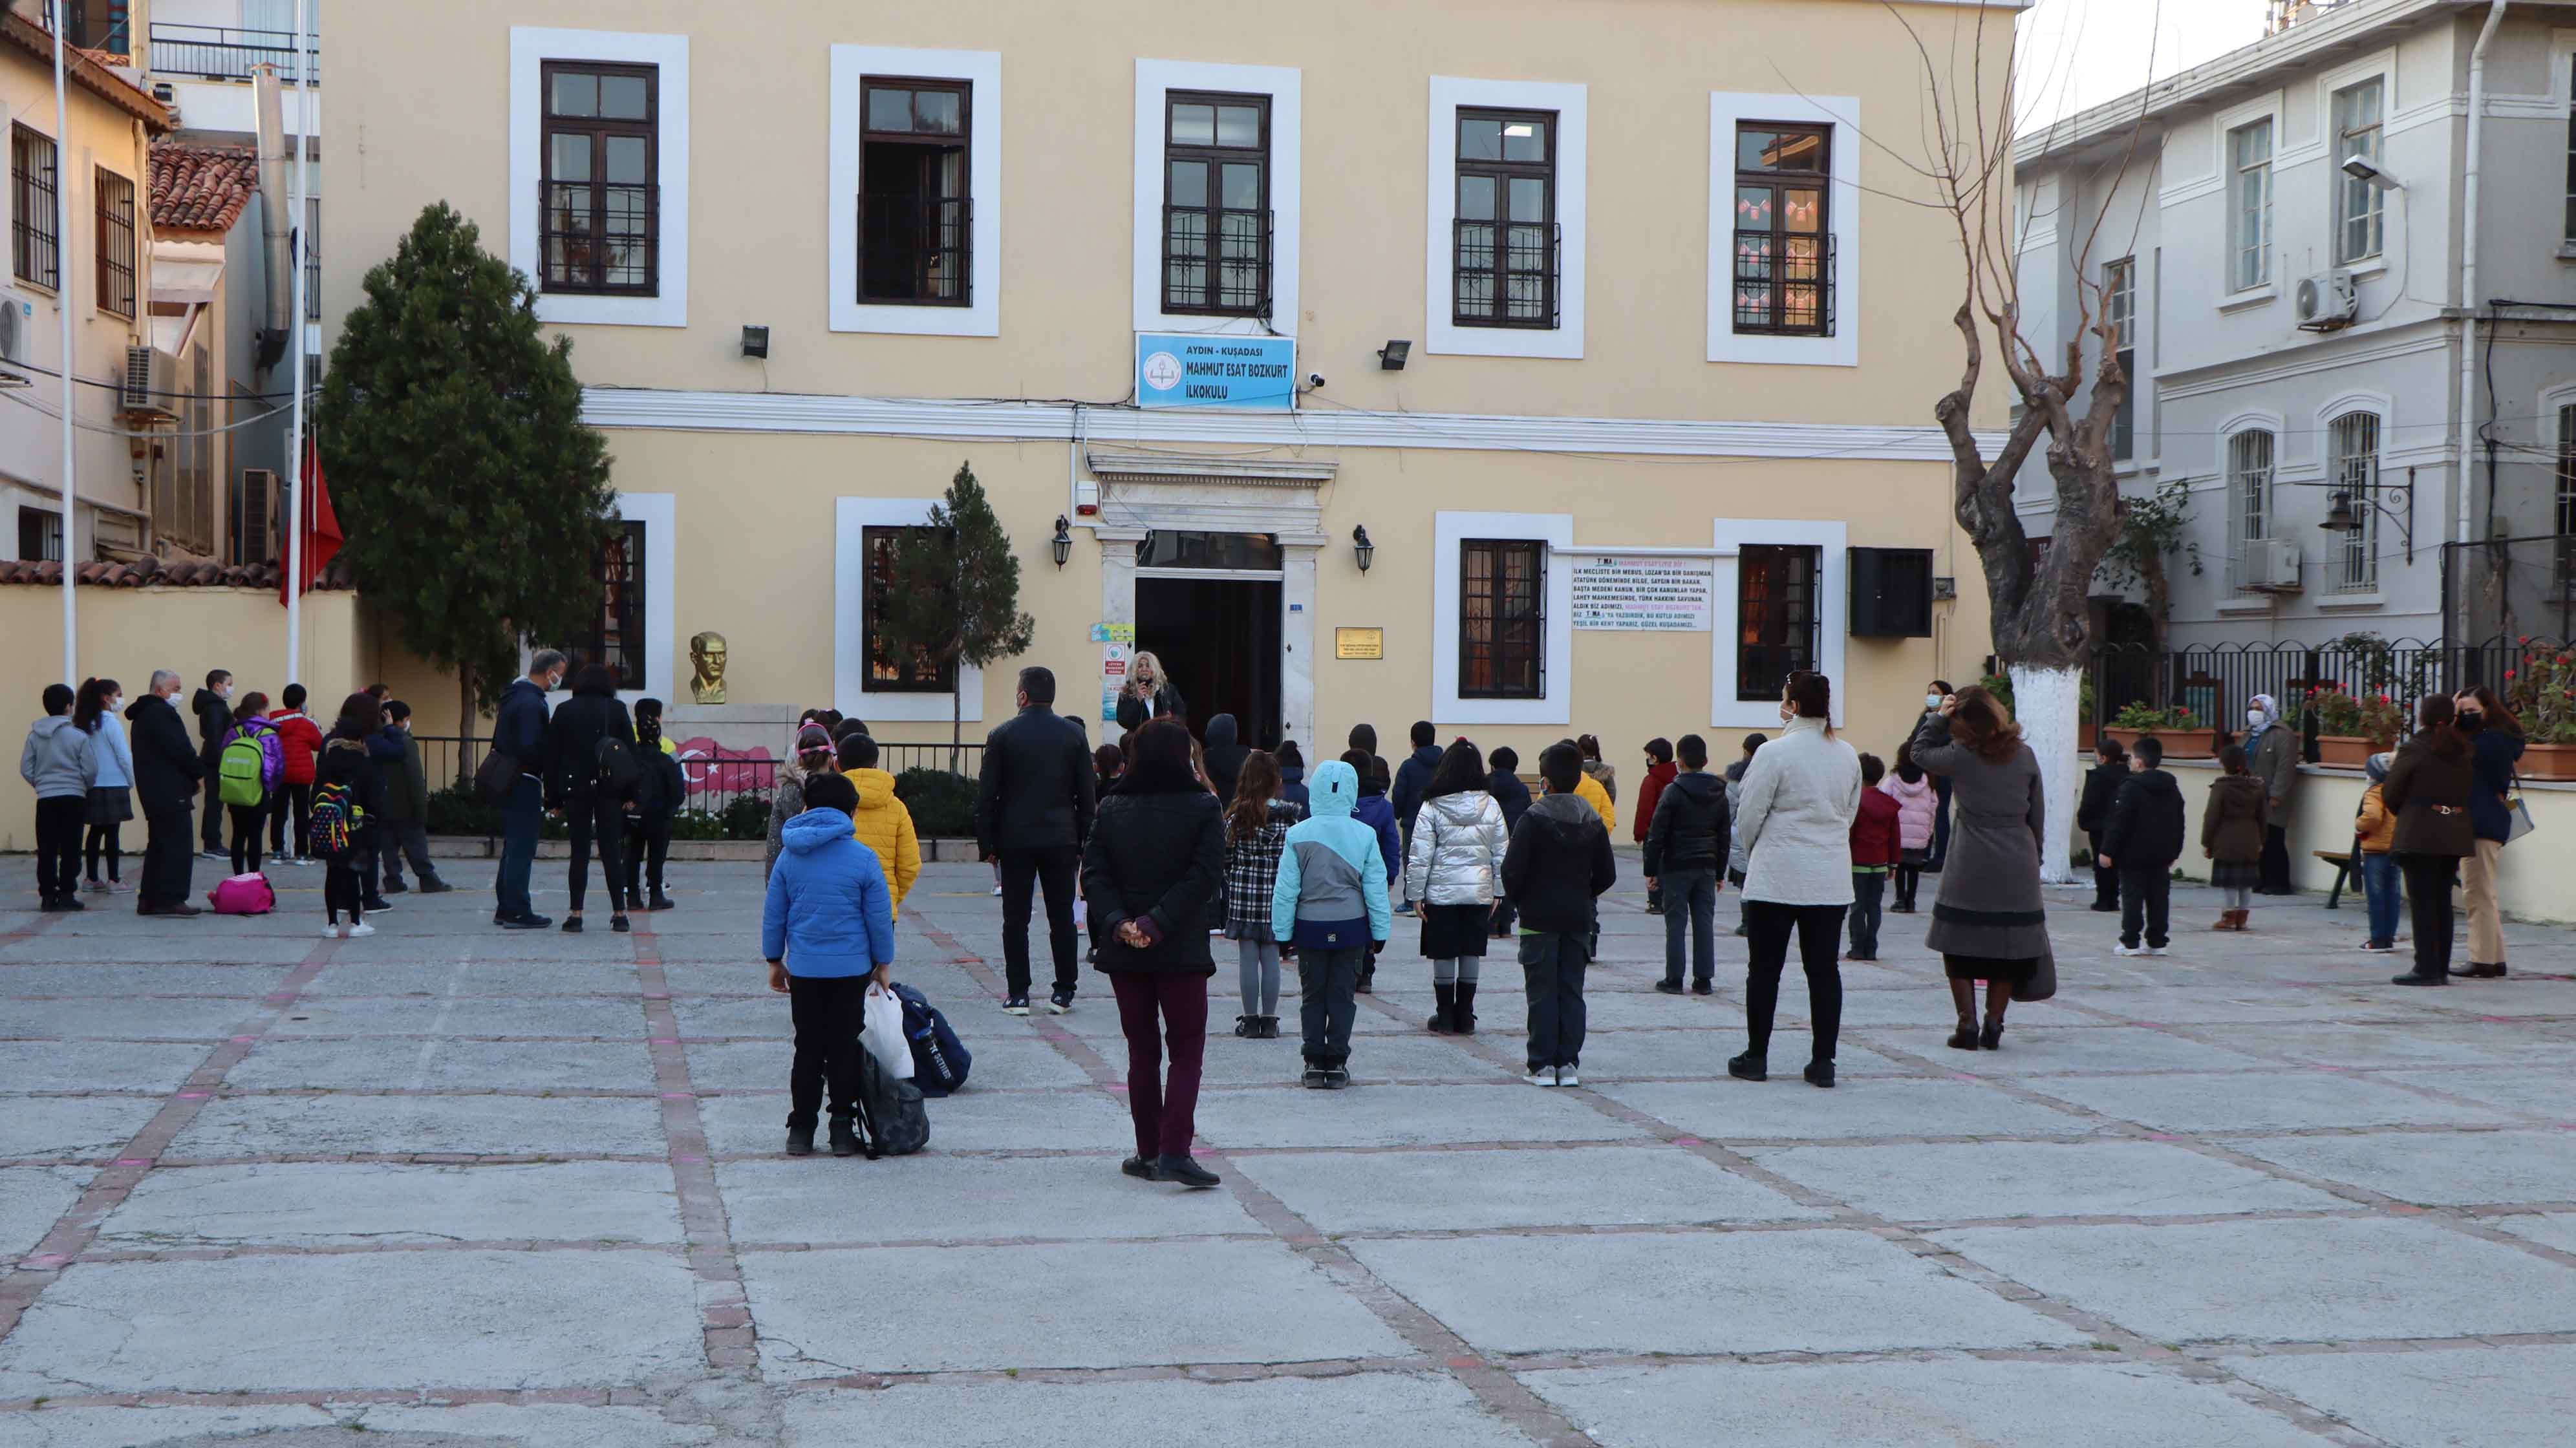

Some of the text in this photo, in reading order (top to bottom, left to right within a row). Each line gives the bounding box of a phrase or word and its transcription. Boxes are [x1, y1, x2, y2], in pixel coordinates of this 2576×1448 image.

[1186, 346, 1214, 355] AYDIN
[1221, 347, 1263, 358] KUŞADASI
[1186, 362, 1288, 378] MAHMUT ESAT BOZKURT
[1186, 381, 1228, 399] İLKOKULU
